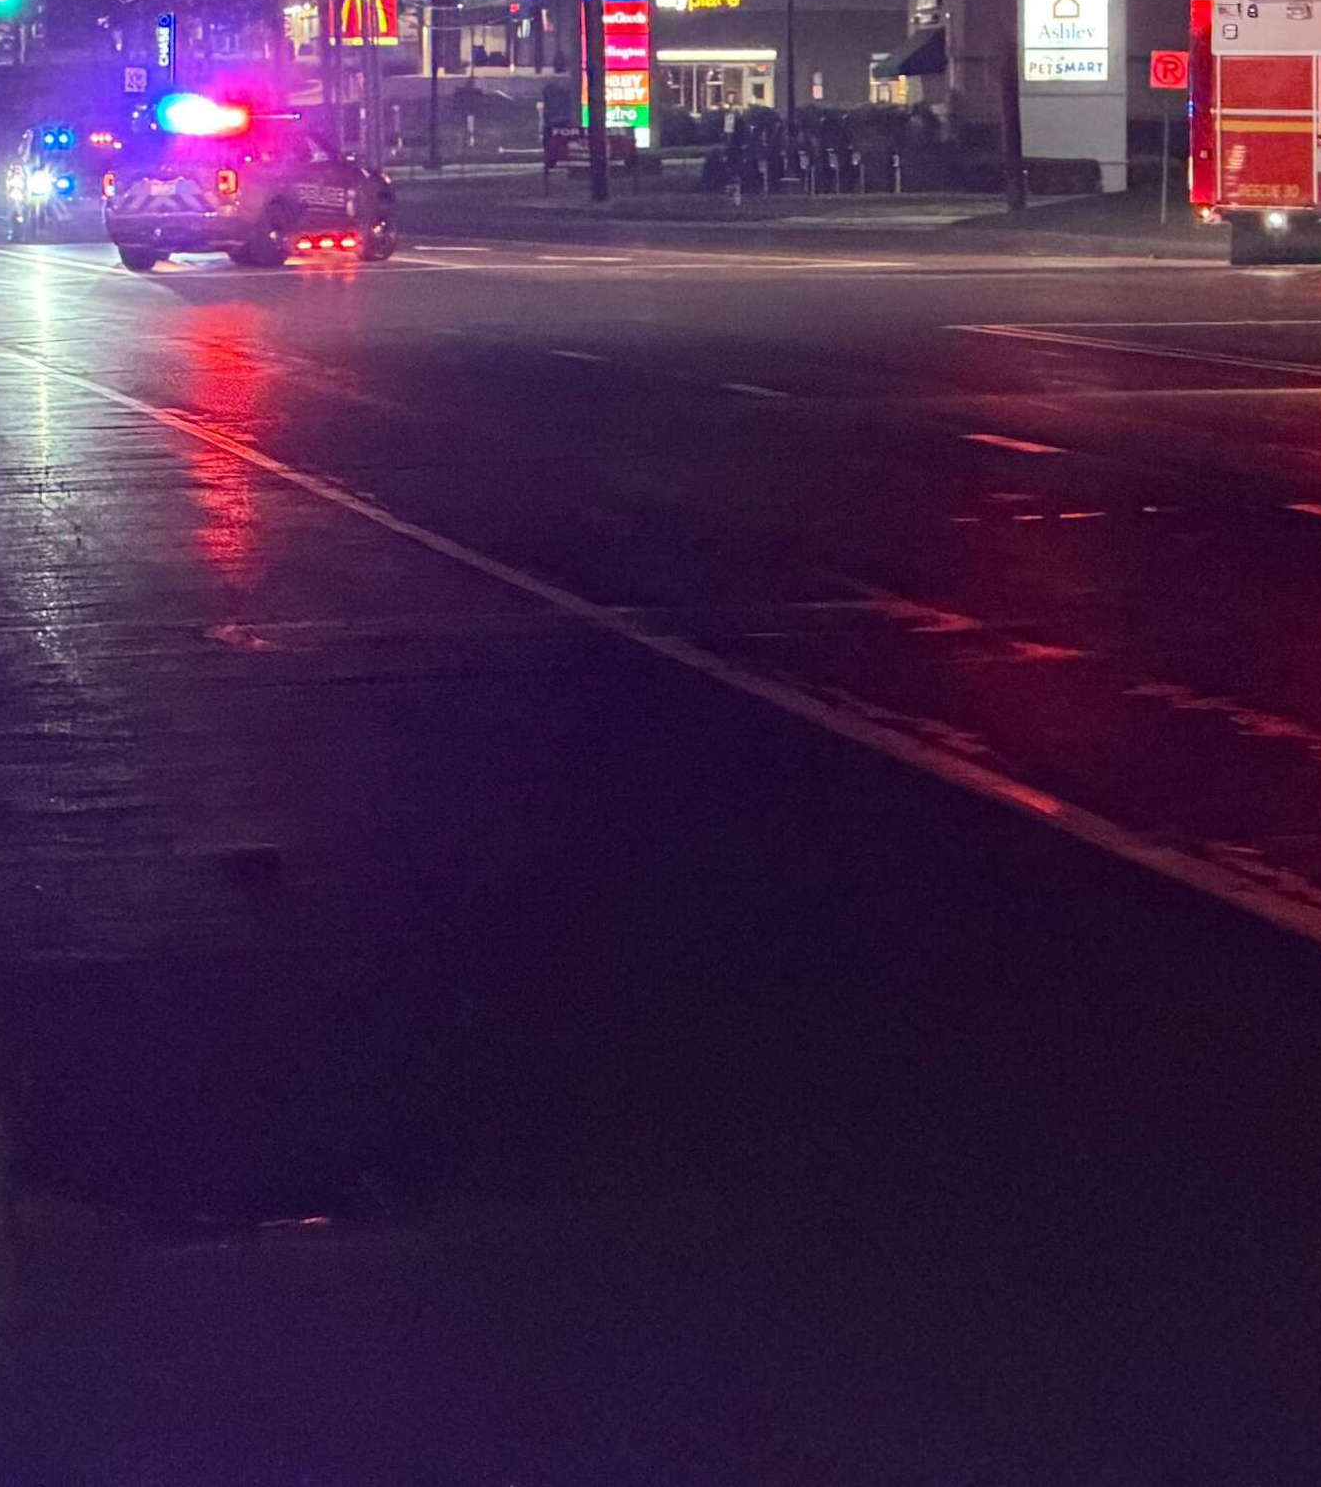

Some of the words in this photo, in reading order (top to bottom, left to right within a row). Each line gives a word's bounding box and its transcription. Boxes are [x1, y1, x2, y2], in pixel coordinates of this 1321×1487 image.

[1038, 21, 1095, 41] Ashley
[157, 26, 170, 67] CHASE
[1029, 62, 1103, 74] PETSMART
